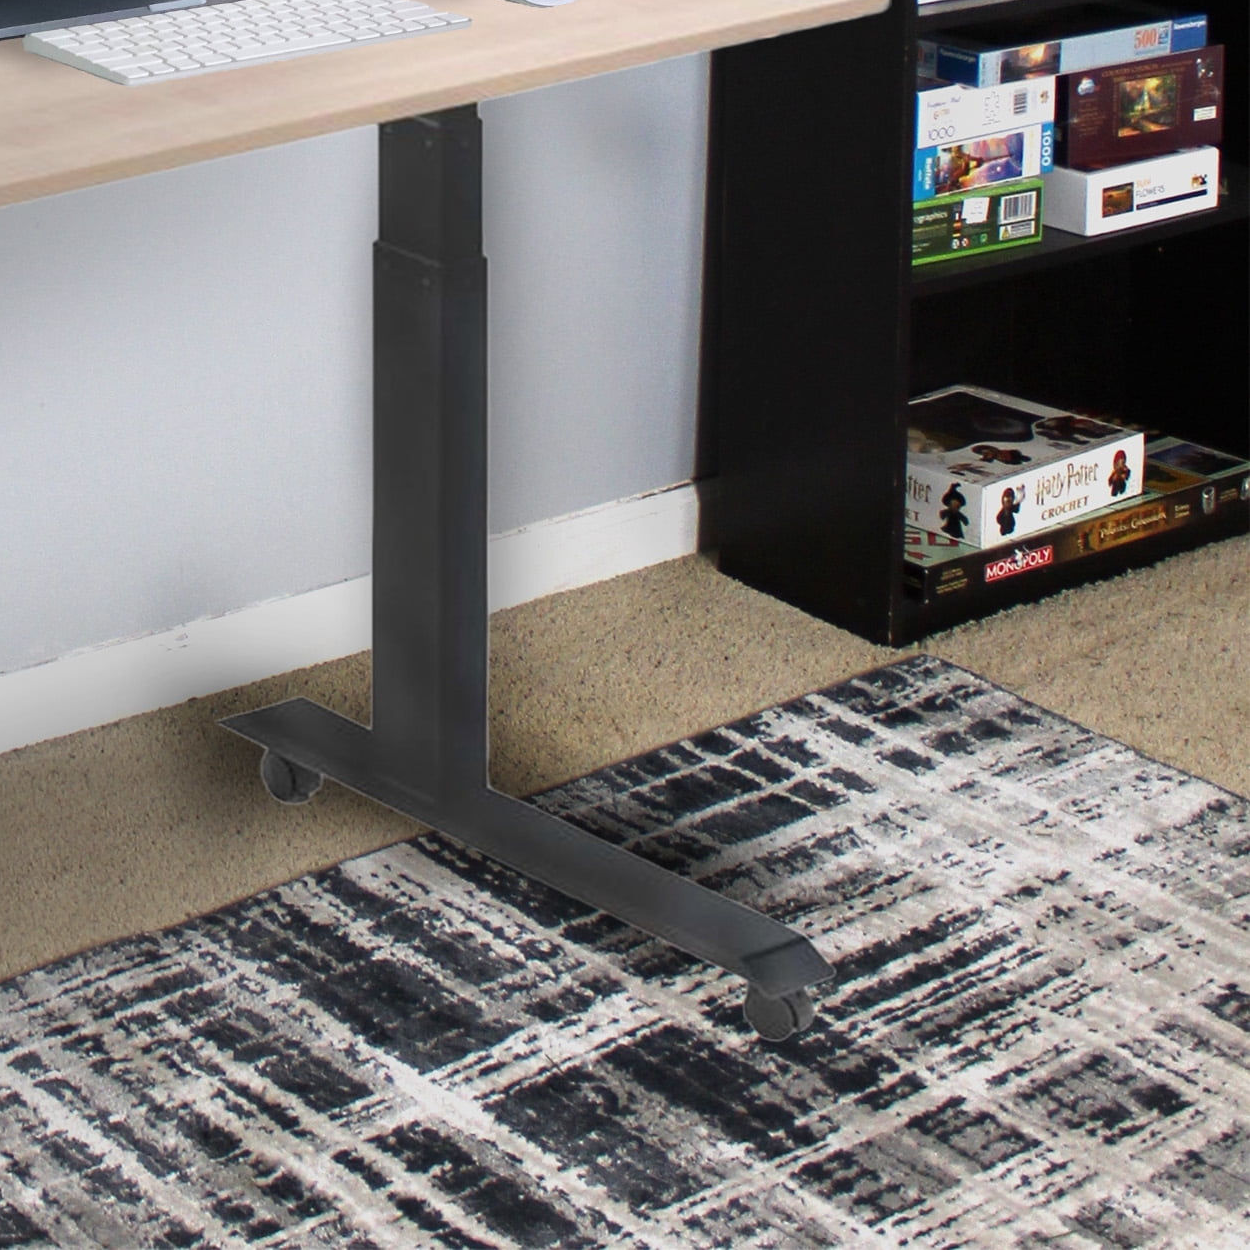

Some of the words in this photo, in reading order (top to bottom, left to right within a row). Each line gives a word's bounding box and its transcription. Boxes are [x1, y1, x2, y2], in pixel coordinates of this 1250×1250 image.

[1134, 27, 1158, 49] 500
[1042, 130, 1051, 166] 1000
[1035, 472, 1064, 505] Harry
[1067, 463, 1099, 495] Potter
[1041, 496, 1088, 521] CROCHET
[986, 547, 1051, 579] MONOPOLY
